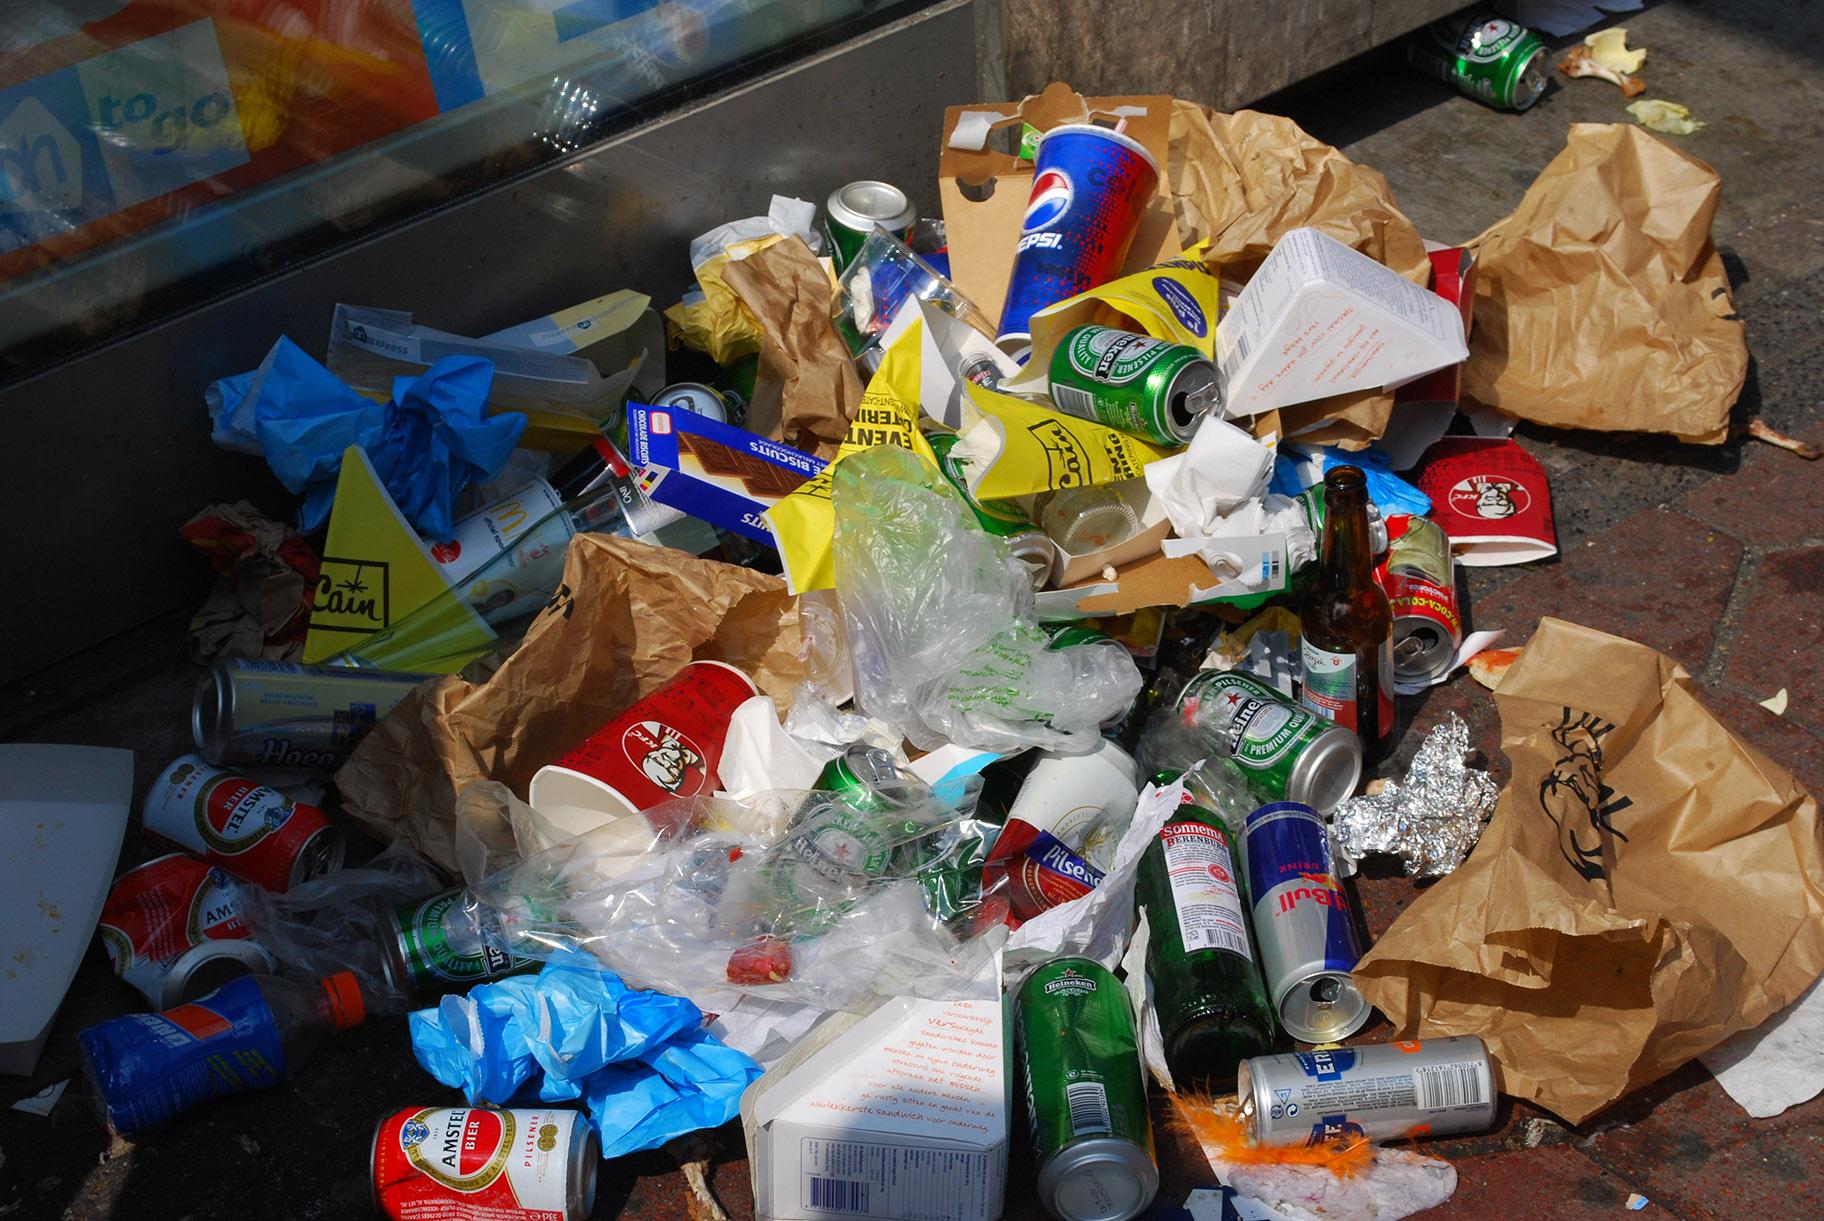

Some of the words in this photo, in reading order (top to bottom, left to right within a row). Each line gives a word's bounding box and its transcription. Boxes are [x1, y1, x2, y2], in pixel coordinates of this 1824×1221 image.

[1097, 333, 1140, 373] neken
[749, 441, 810, 472] BISCUITS
[1108, 431, 1134, 480] RING
[1215, 678, 1262, 696] PILSENER
[626, 727, 658, 750] KFC
[1249, 729, 1292, 756] PREMIUM
[227, 785, 275, 834] AMSTEL
[1280, 888, 1332, 913] Bull
[1048, 978, 1095, 990] Heineken
[951, 1062, 995, 1078] onderweg
[868, 1080, 887, 1089] voor
[890, 1084, 905, 1092] alle
[908, 1087, 937, 1098] andere
[874, 1093, 898, 1105] rustig
[966, 1108, 982, 1117] van
[985, 1110, 997, 1119] de
[875, 1107, 924, 1122] sandwich
[926, 1115, 946, 1124] voor
[948, 1118, 990, 1134] onderweg
[441, 1107, 467, 1168] AMSTEL
[464, 1118, 480, 1152] BIER
[524, 1114, 541, 1168] PILSENER
